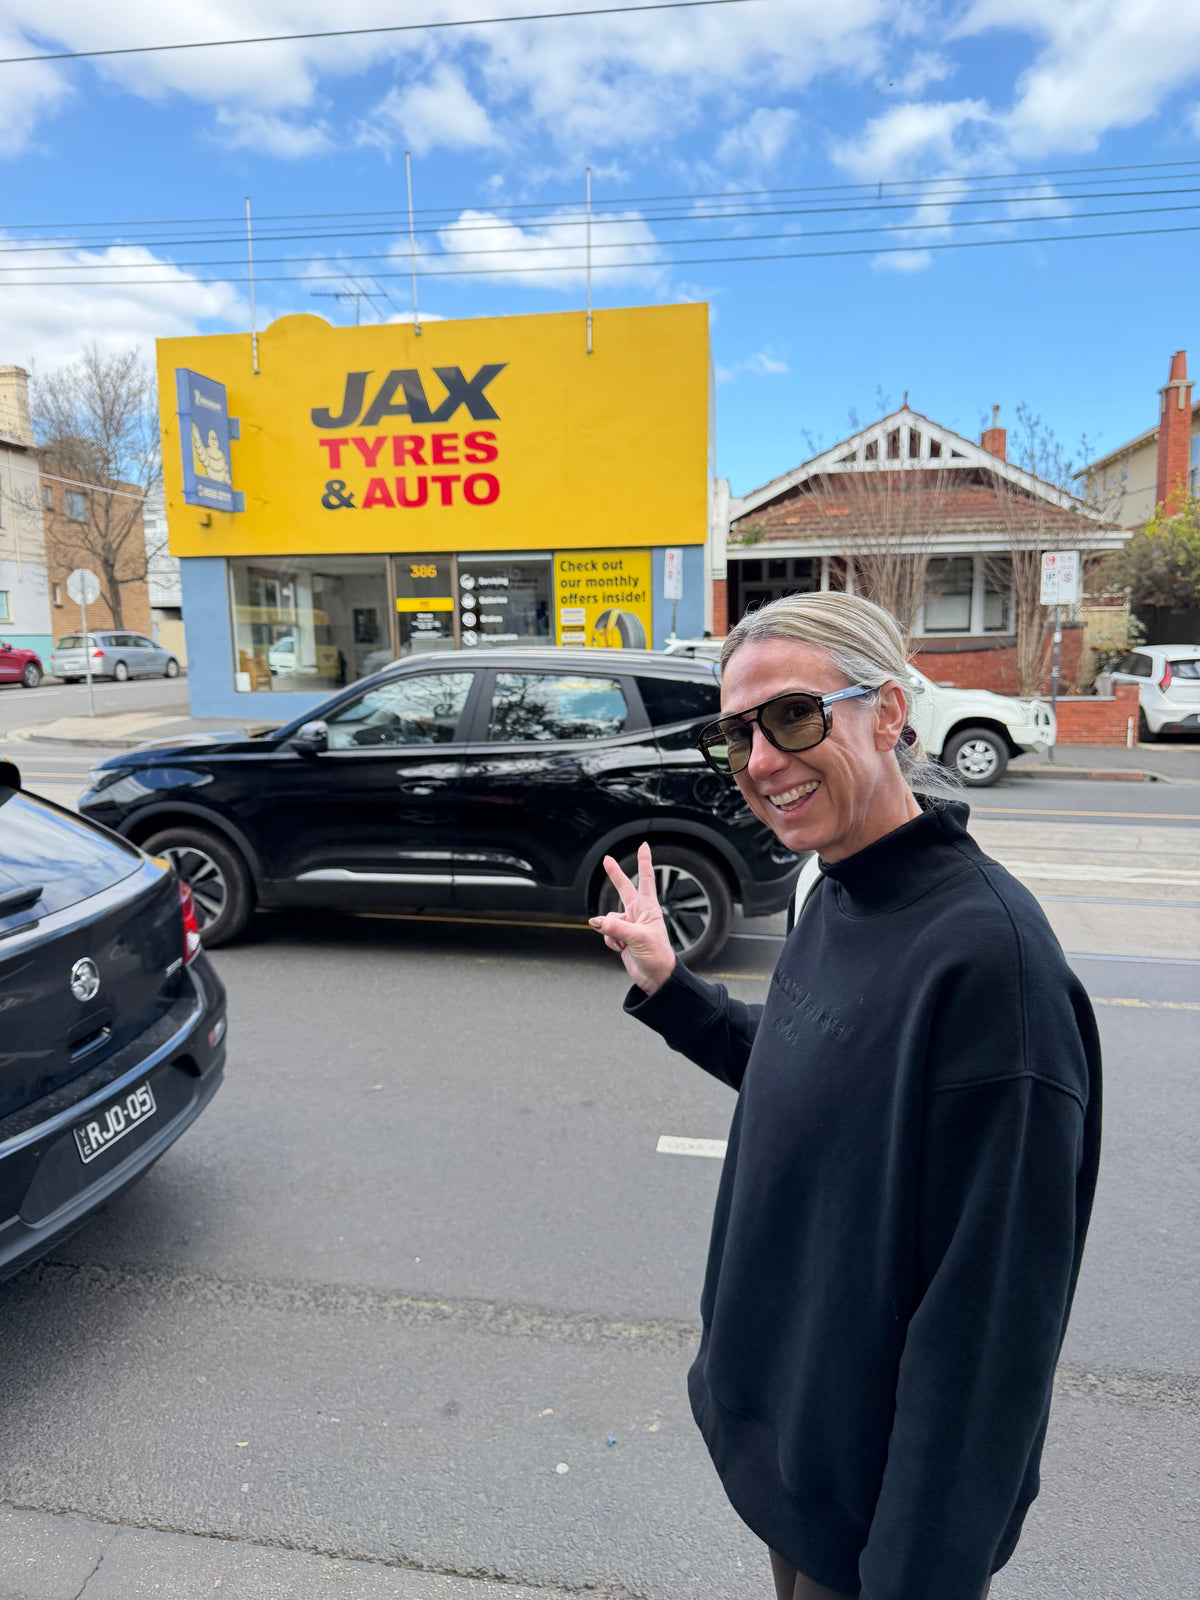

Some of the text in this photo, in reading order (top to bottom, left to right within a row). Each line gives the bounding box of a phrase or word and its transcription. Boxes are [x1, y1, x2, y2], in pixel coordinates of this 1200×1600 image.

[311, 363, 509, 429] JAX
[319, 431, 499, 469] TYRES
[321, 473, 500, 510] & AUTO
[560, 560, 623, 572] Check out
[560, 576, 639, 588] our monthly
[561, 591, 646, 604] offers inside!
[79, 1128, 92, 1155] VIC
